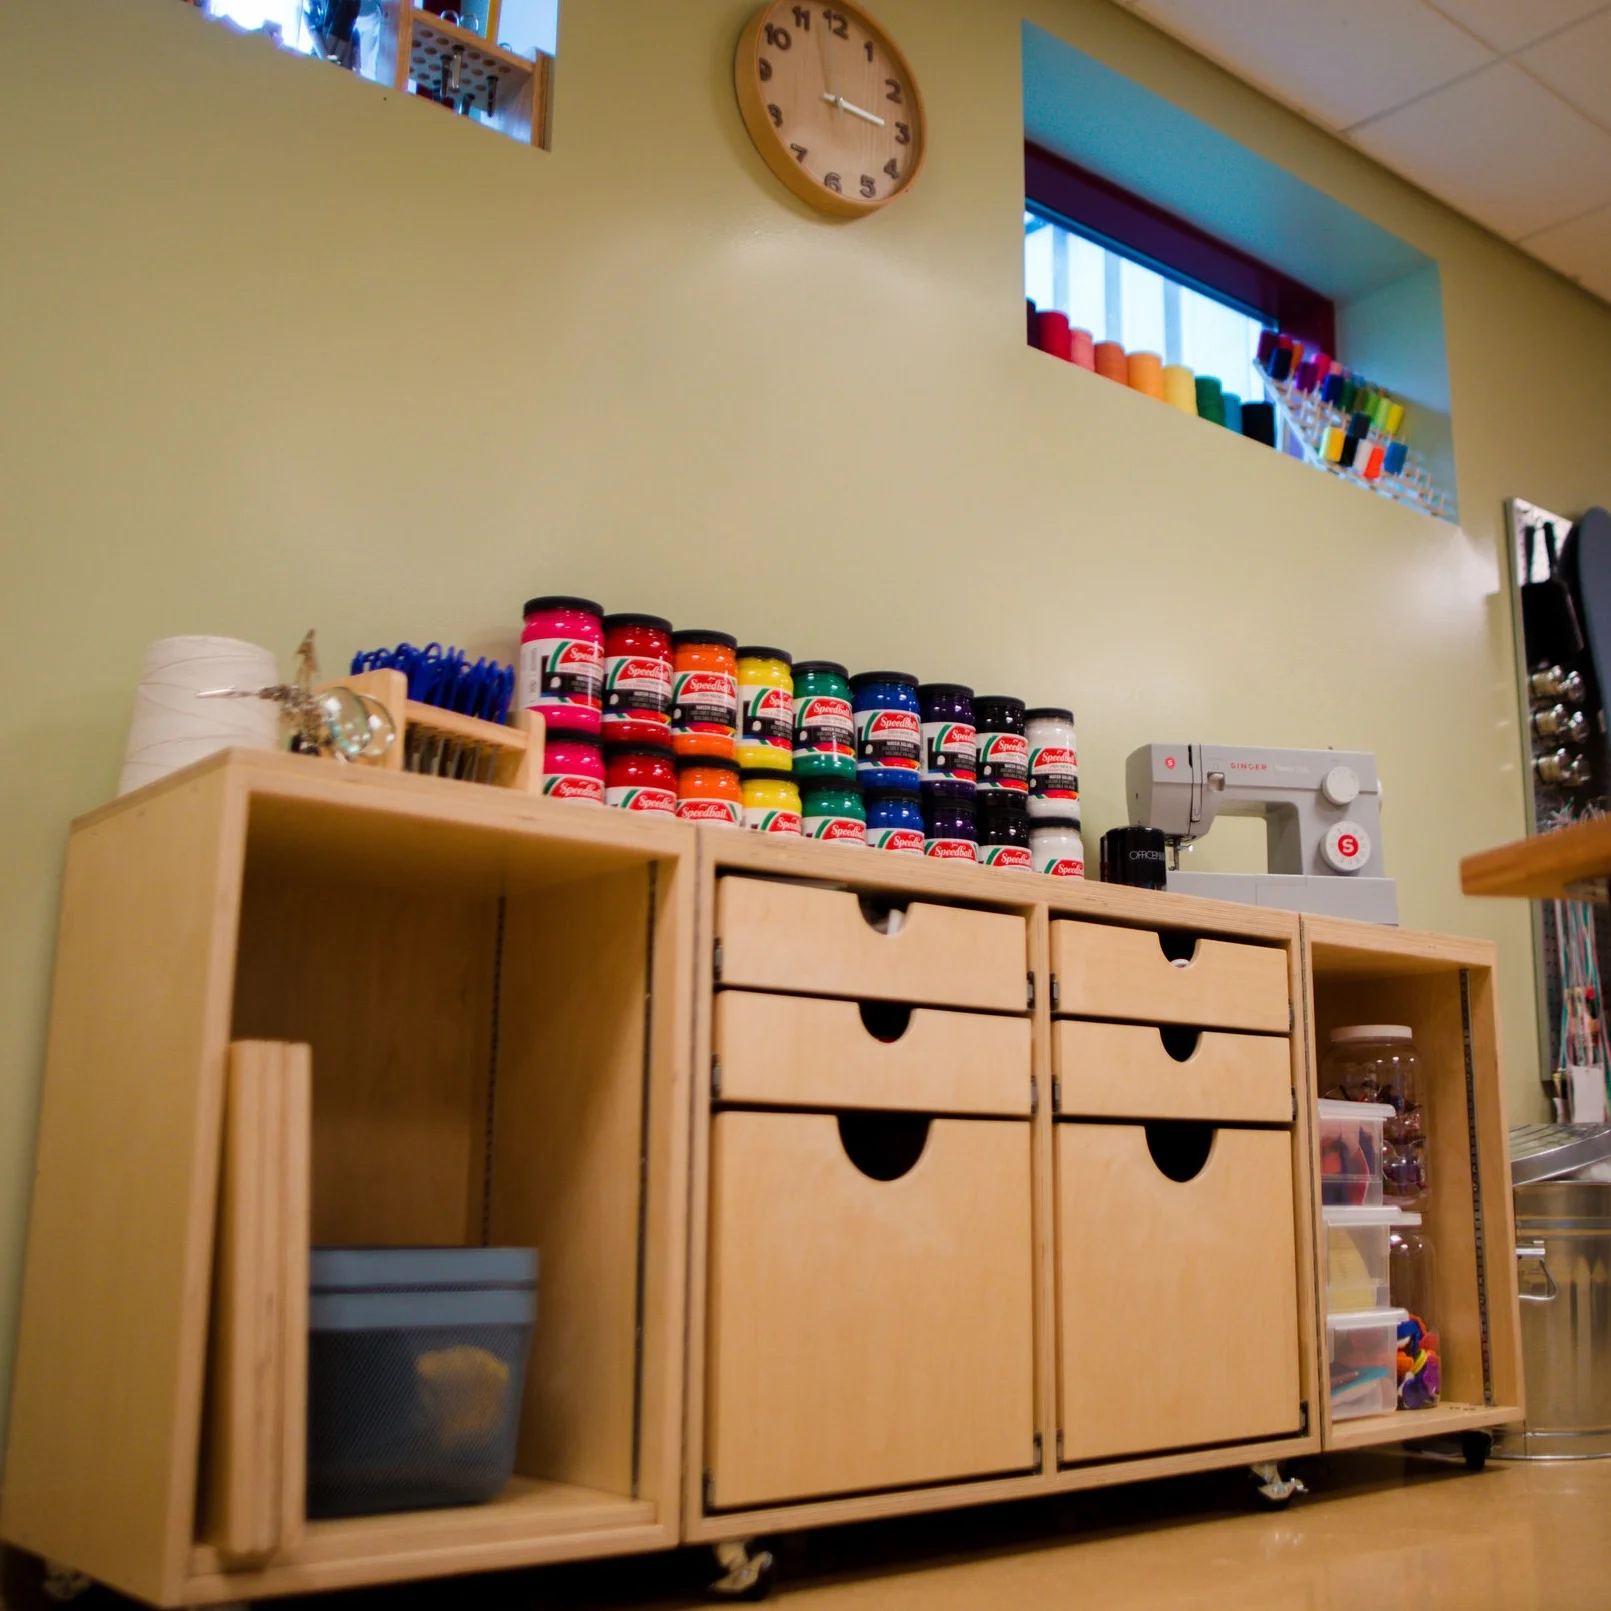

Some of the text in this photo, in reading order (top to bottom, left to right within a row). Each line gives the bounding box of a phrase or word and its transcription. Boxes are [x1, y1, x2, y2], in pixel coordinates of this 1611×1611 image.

[792, 5, 811, 32] 11
[822, 9, 849, 40] 12
[764, 22, 792, 51] 10
[864, 40, 874, 63] 1
[884, 78, 902, 104] 2
[894, 121, 911, 146] 3
[790, 142, 808, 164] 7
[883, 157, 900, 180] 4
[823, 172, 843, 195] 6
[859, 173, 877, 199] 5
[1229, 761, 1268, 771] SINGER
[682, 803, 727, 818] Speedball
[935, 843, 972, 859] Speedball
[1341, 838, 1355, 853] S
